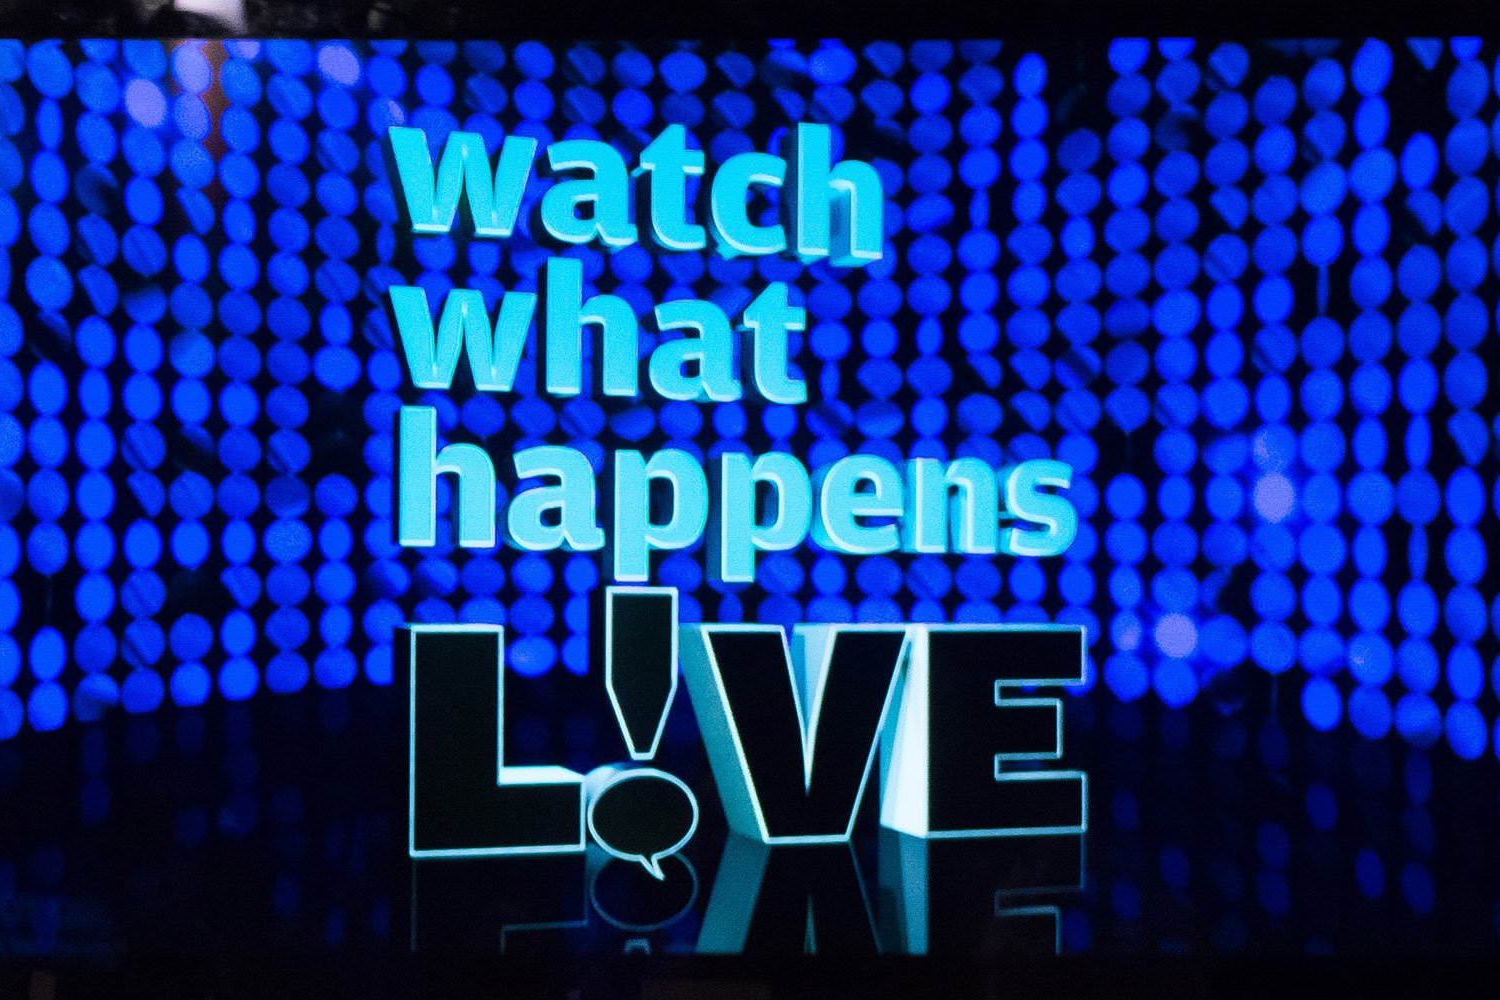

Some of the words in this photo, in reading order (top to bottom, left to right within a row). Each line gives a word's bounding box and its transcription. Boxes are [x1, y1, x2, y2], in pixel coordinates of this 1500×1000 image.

[388, 123, 884, 267] watch
[388, 257, 807, 404] what
[398, 405, 1080, 583] happens
